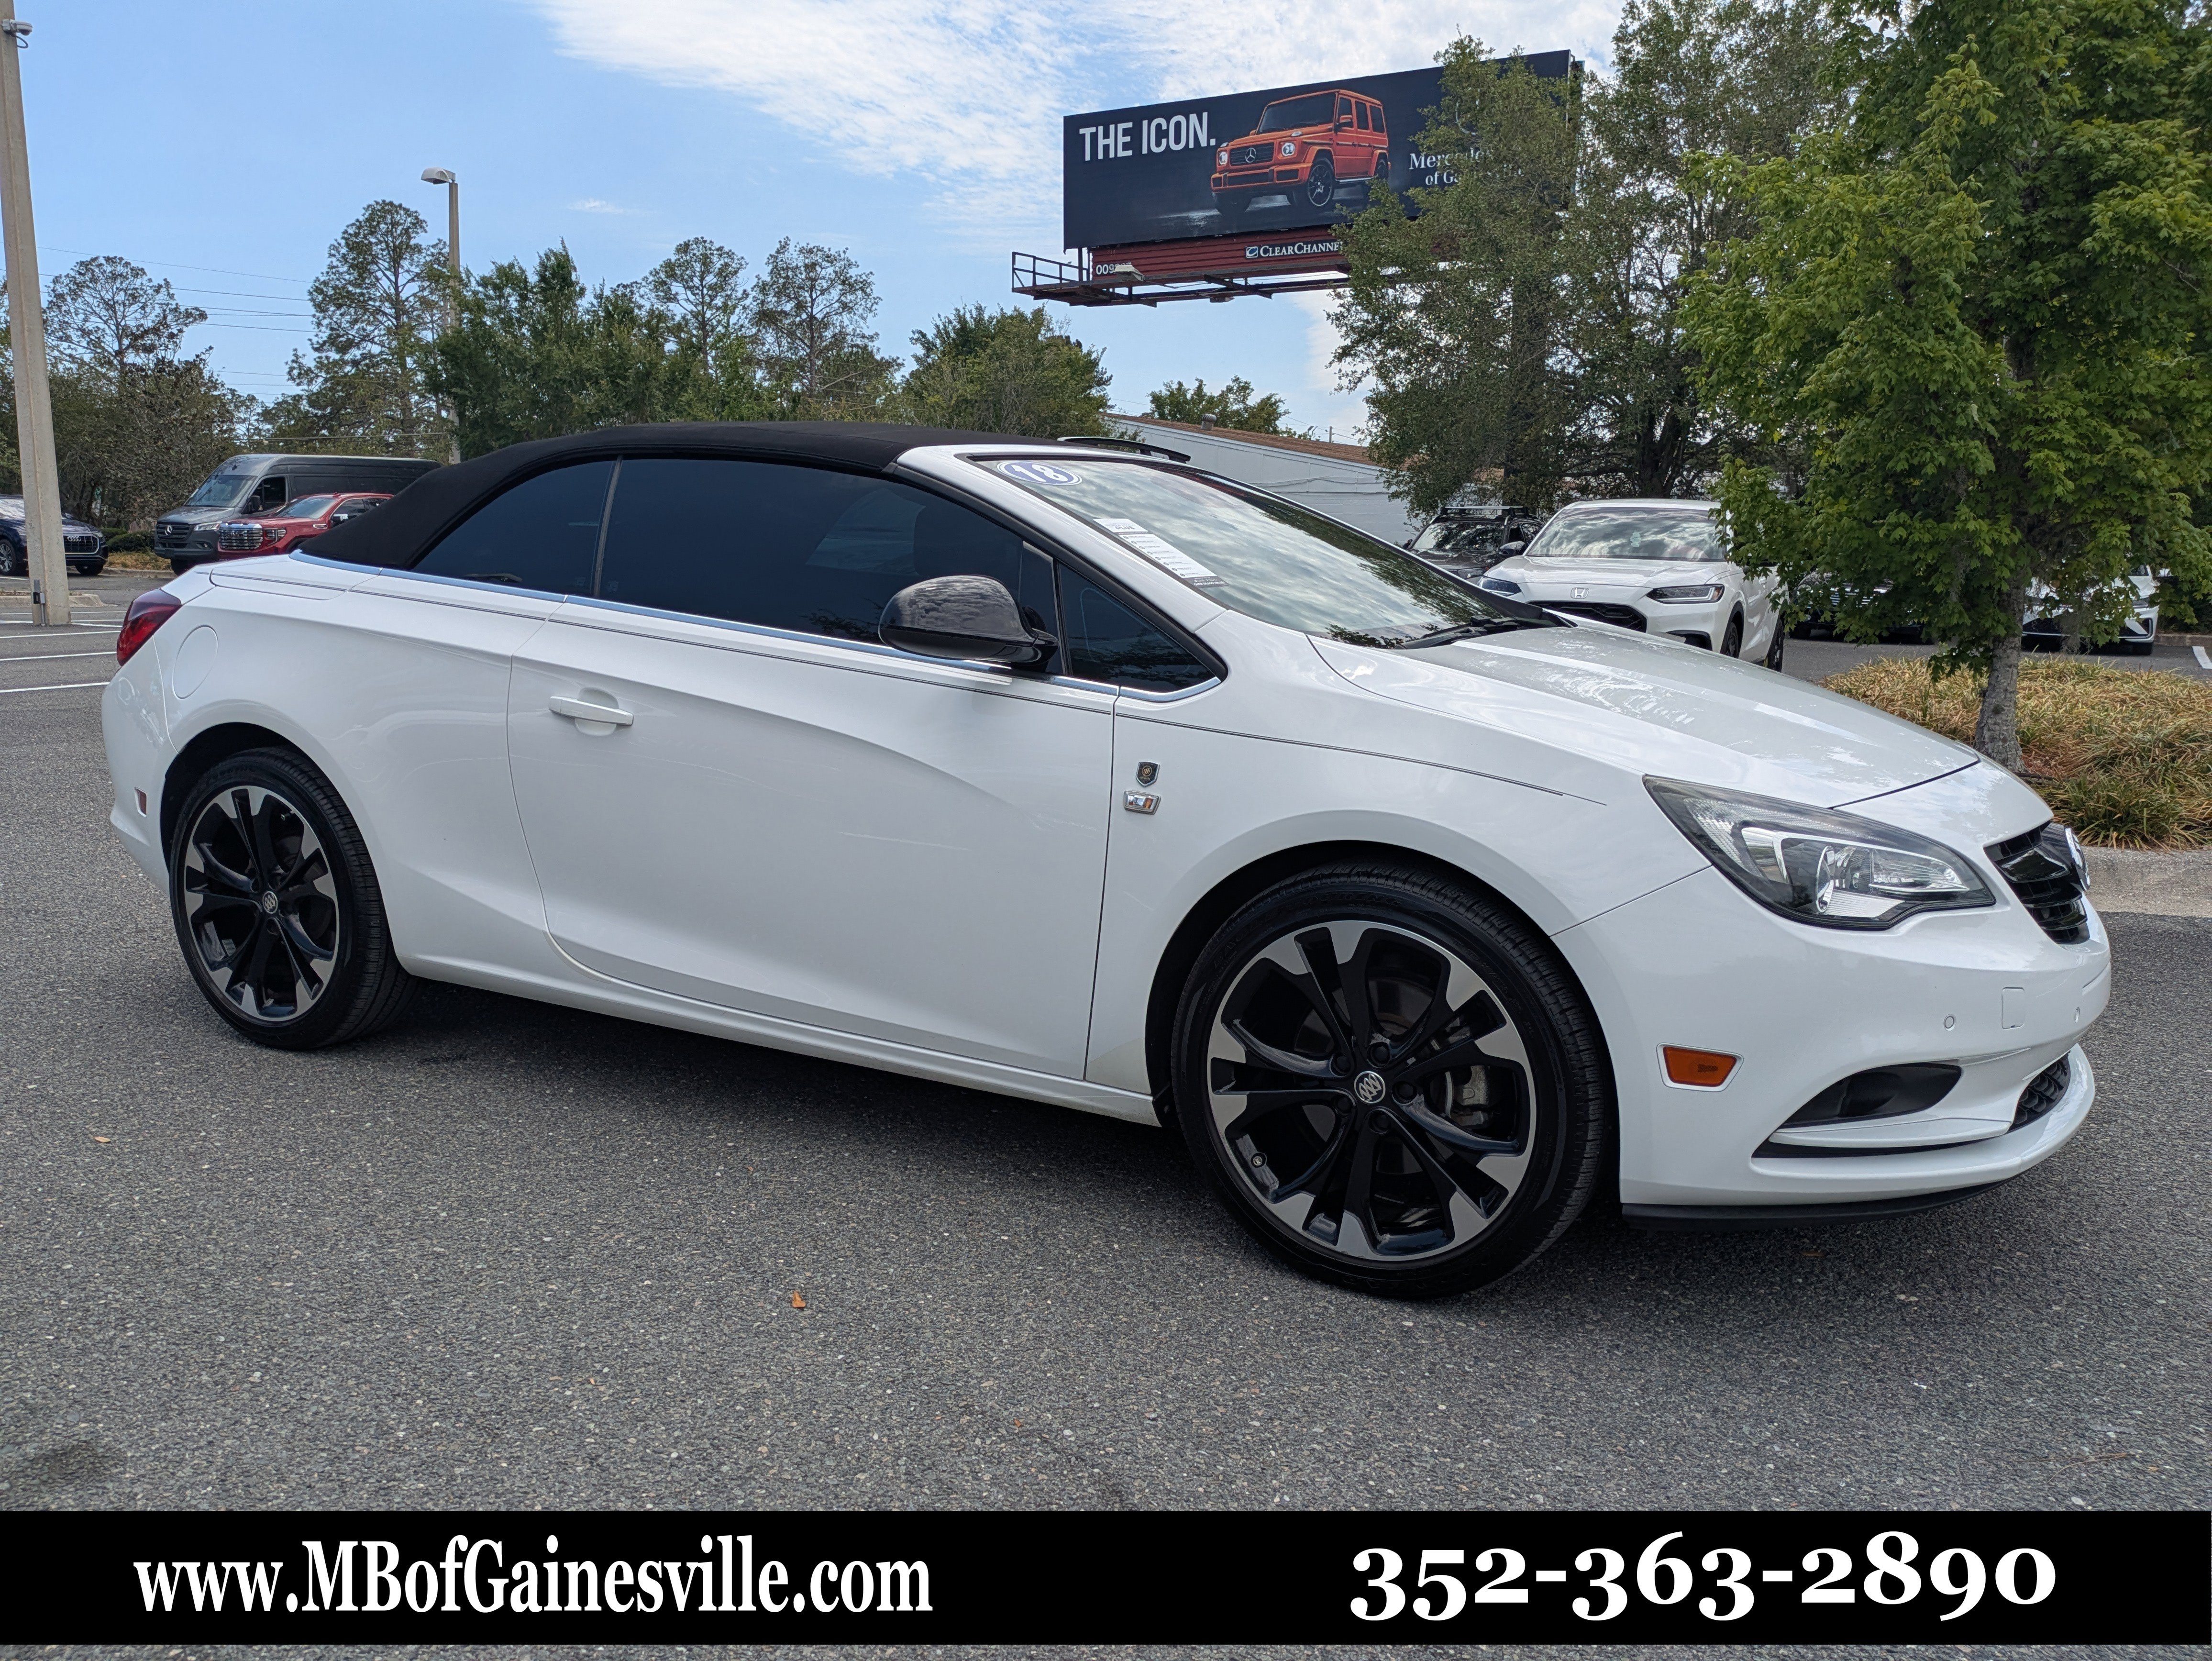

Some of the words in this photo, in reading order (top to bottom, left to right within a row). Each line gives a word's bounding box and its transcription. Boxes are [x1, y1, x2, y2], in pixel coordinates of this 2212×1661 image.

[1079, 122, 1133, 161] THE
[1142, 111, 1216, 155] ICON.
[1425, 171, 1440, 186] of
[1095, 262, 1132, 275] 009
[1011, 464, 1068, 482] 18
